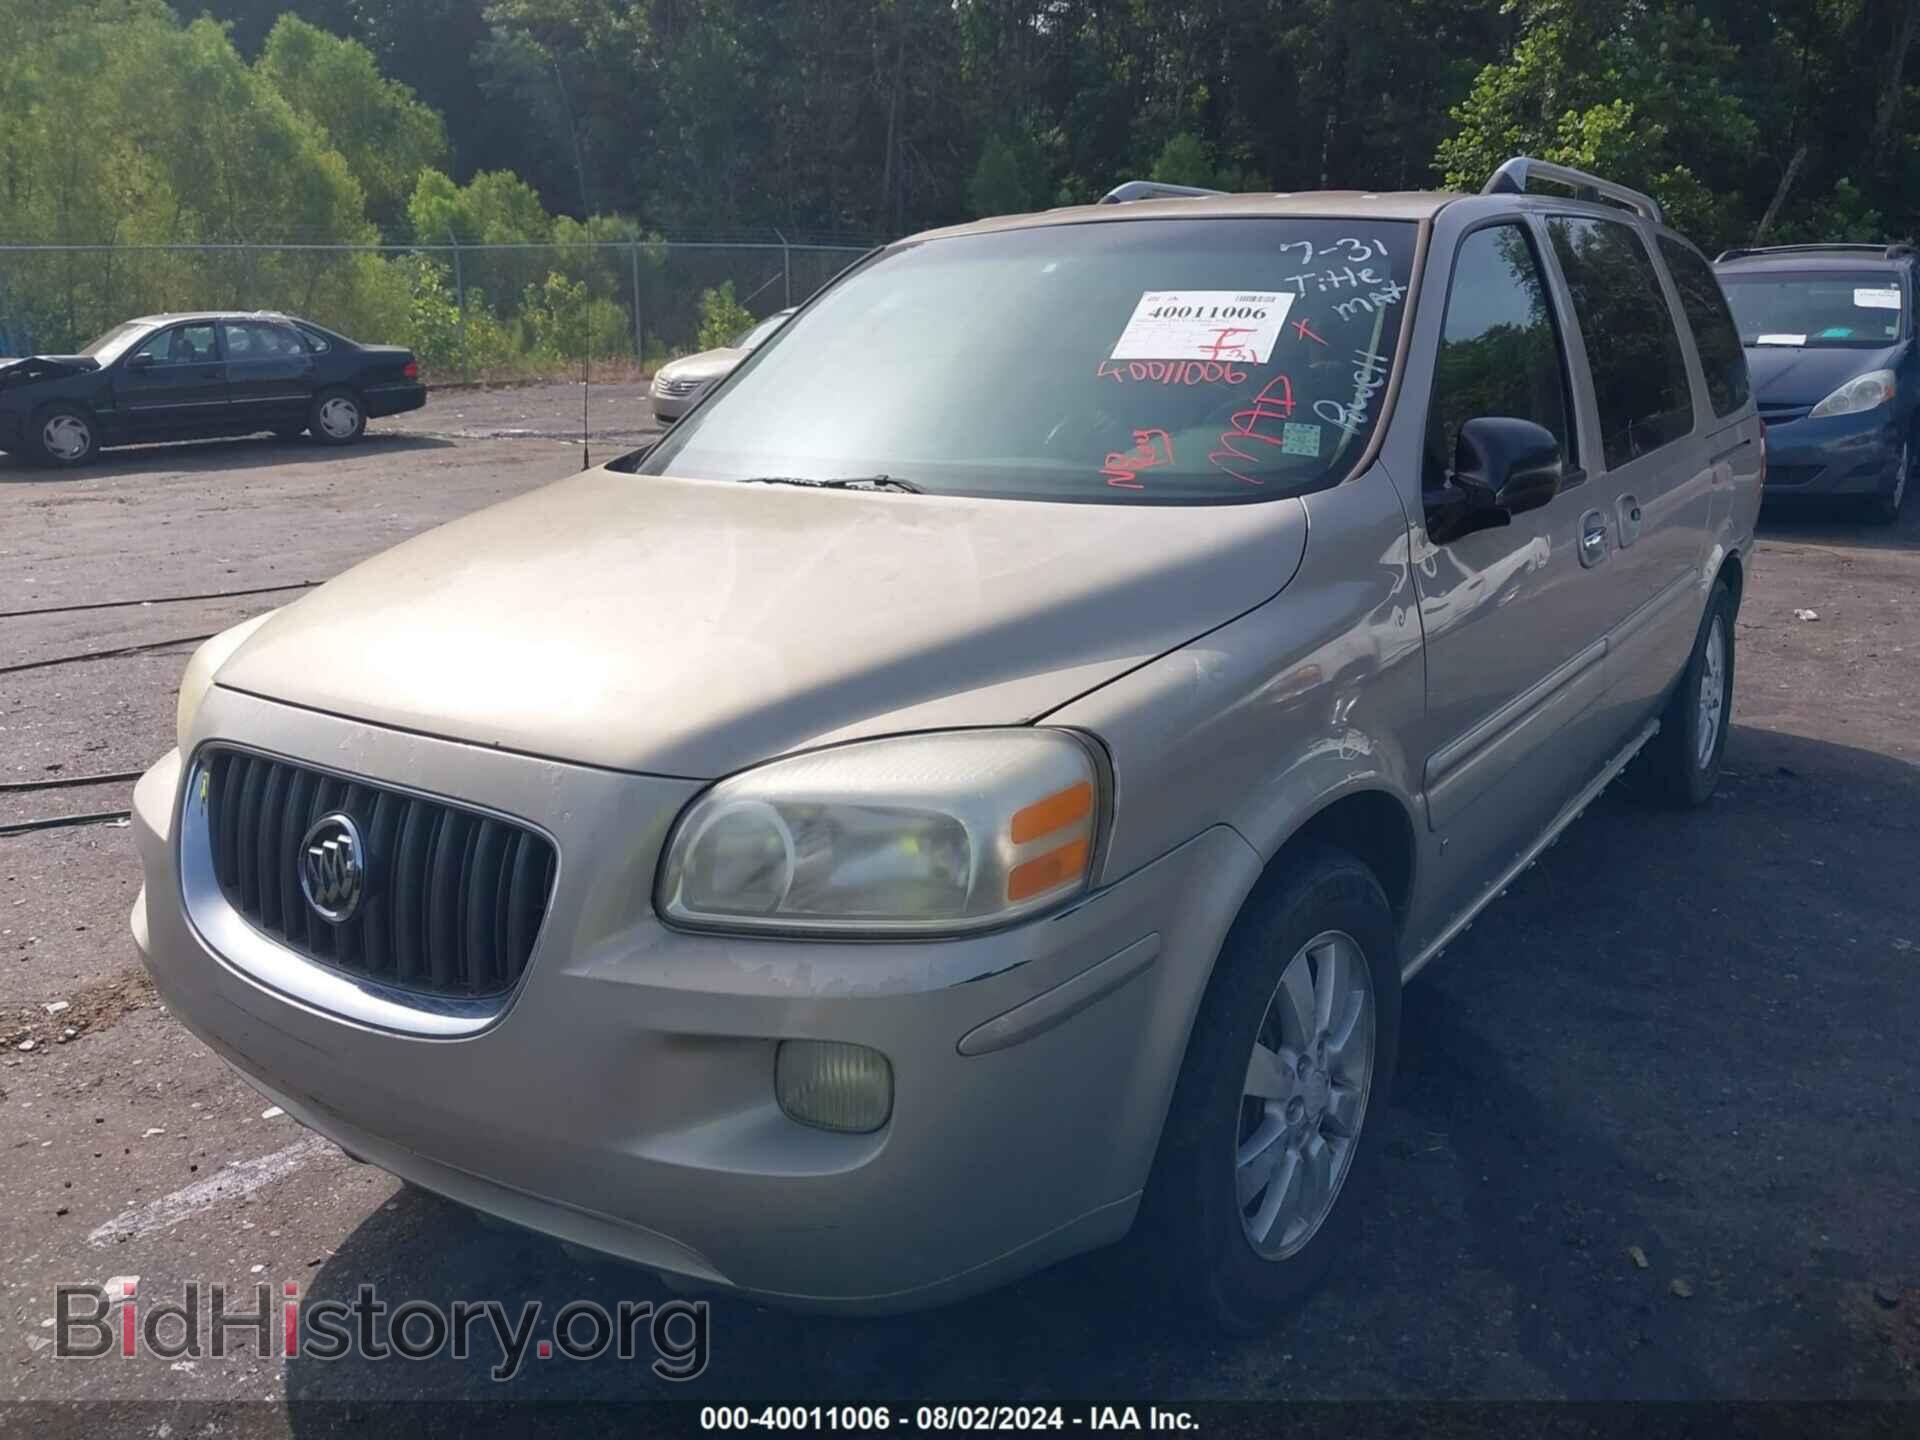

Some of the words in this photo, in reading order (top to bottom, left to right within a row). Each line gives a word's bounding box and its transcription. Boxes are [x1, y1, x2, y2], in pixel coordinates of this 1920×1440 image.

[1280, 238, 1388, 264] 7-31
[1284, 266, 1383, 298] Title
[1148, 306, 1267, 319] 40011006
[1097, 360, 1248, 385] 40011006
